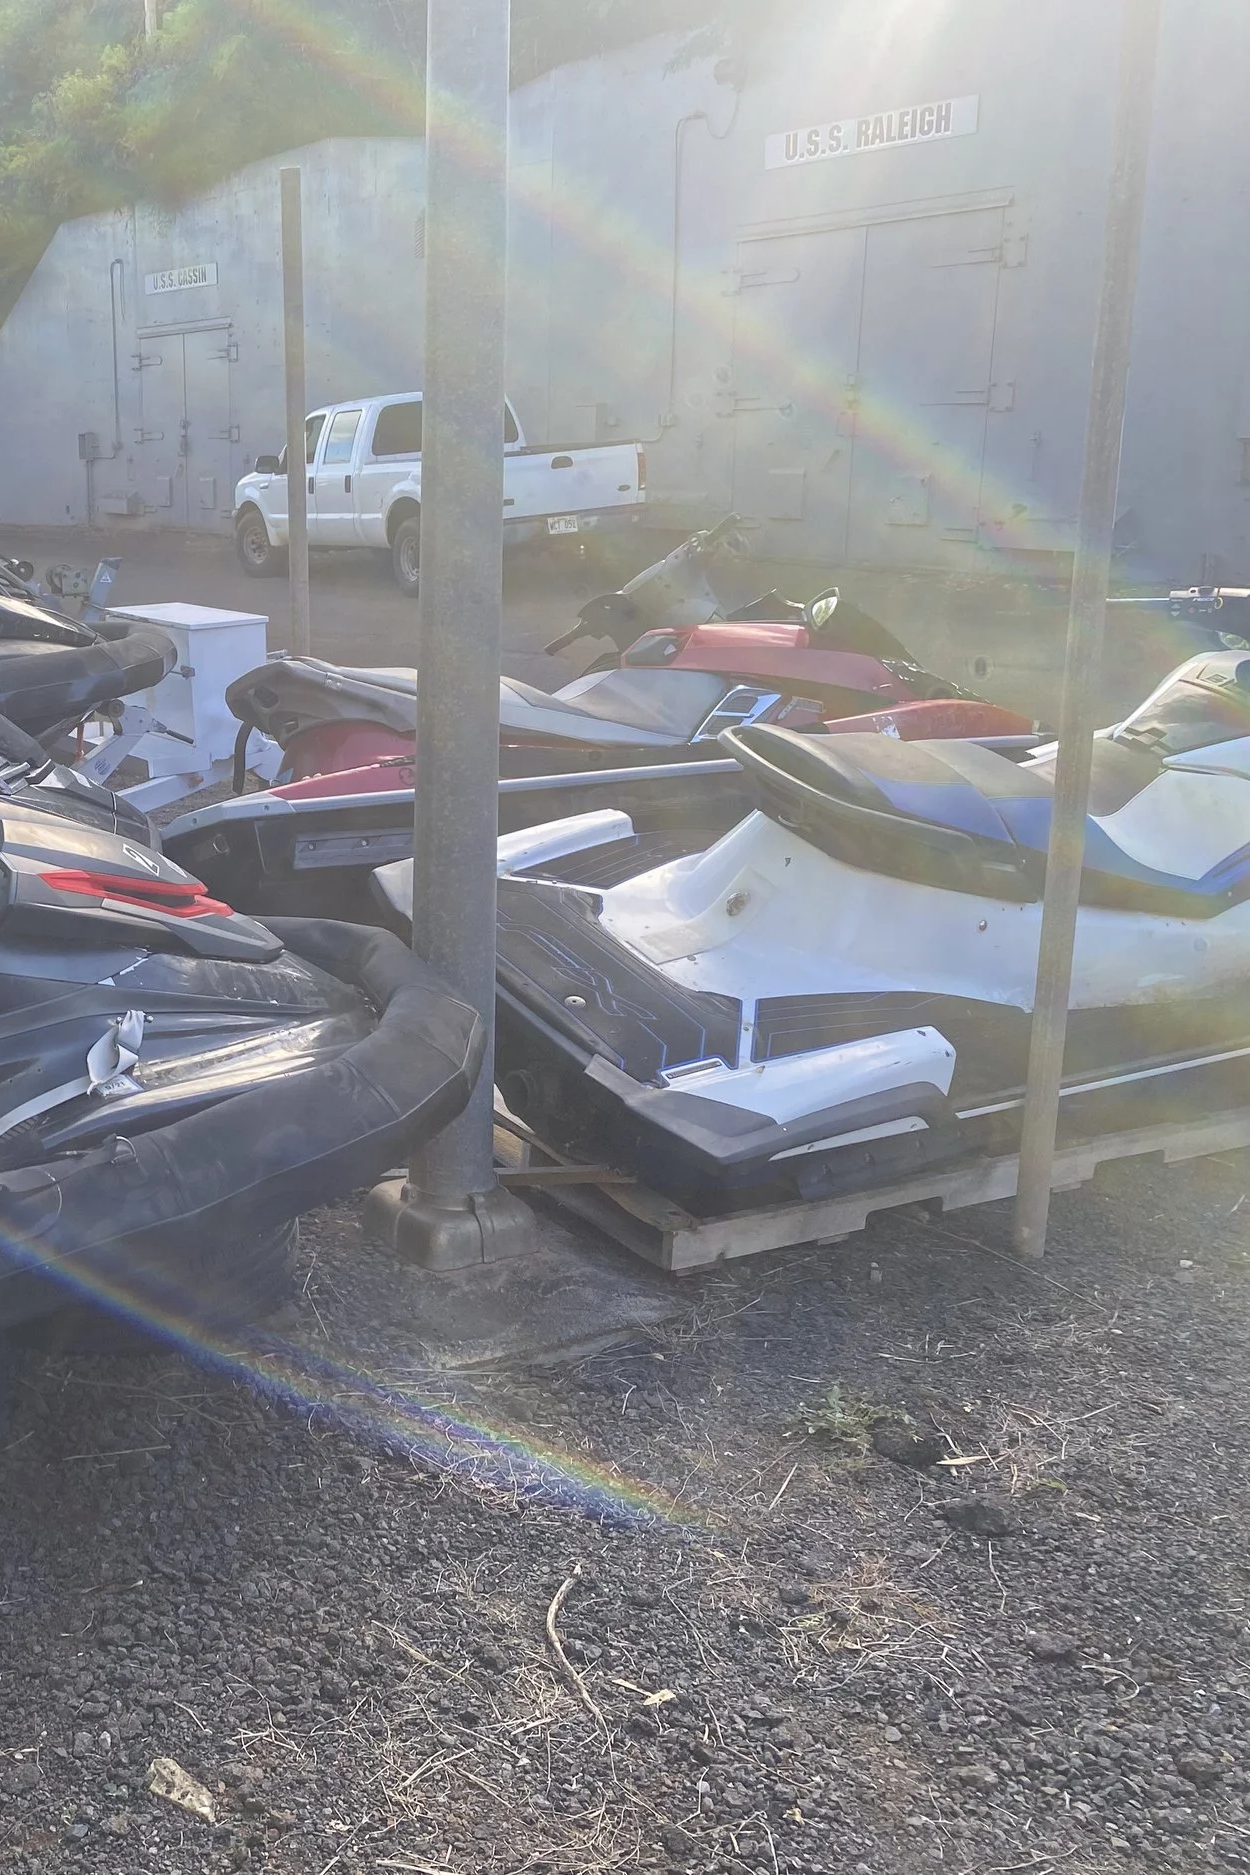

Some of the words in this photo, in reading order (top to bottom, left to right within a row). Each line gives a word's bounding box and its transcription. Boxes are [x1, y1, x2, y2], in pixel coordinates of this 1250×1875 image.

[784, 124, 849, 161] U.S.S.
[855, 102, 952, 149] RALEIGH
[152, 271, 176, 291] U.S.S.
[177, 265, 207, 287] CASSIN
